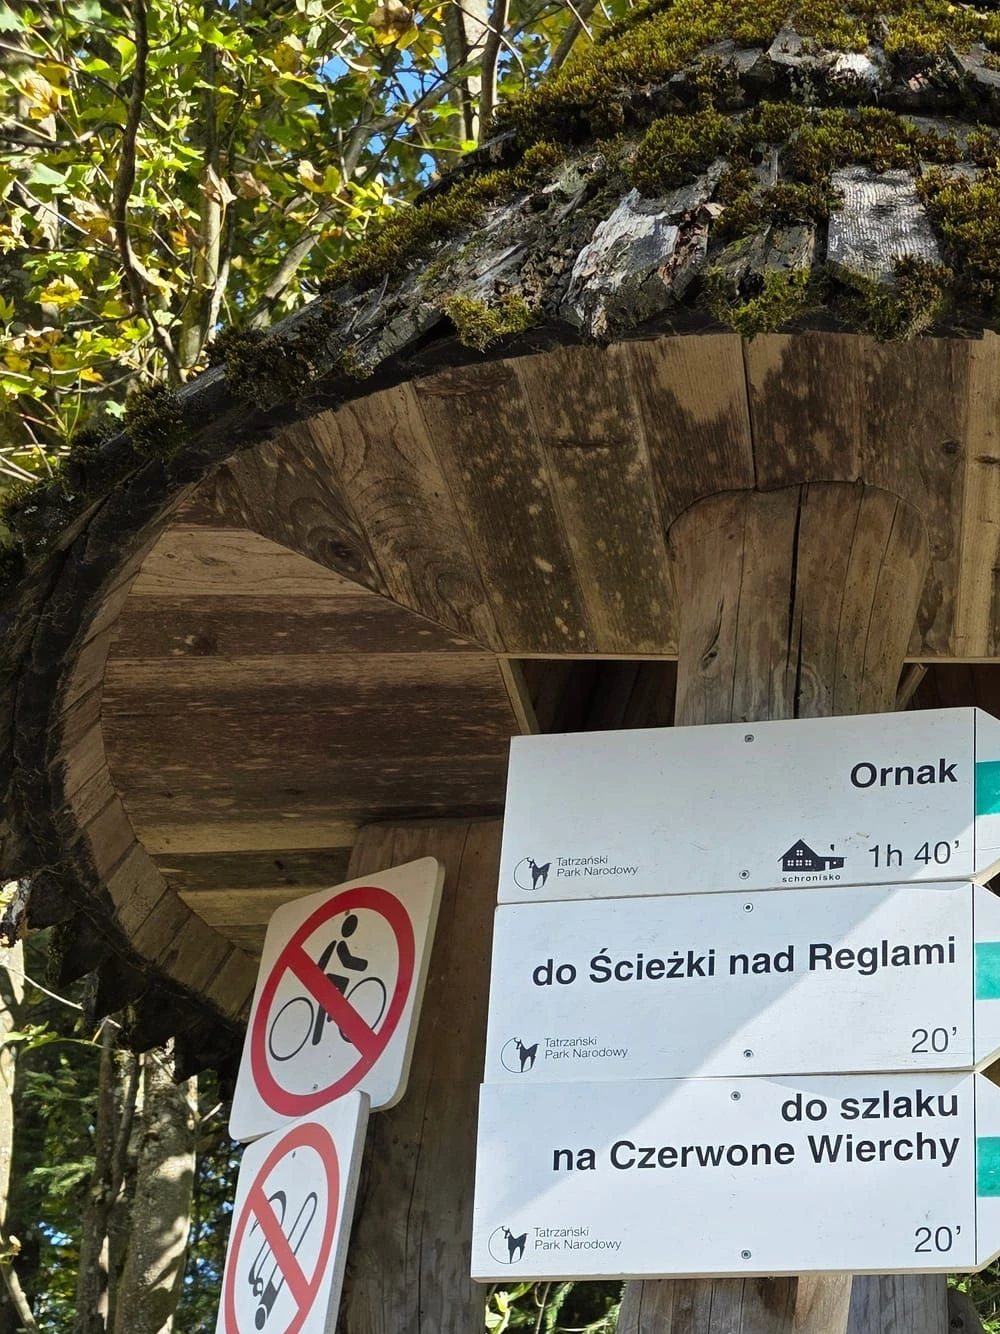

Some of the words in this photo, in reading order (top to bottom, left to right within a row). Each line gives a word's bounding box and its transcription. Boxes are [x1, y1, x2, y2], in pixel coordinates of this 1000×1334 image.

[850, 757, 958, 789] Ornak
[868, 843, 903, 868] 1h
[556, 867, 582, 878] Park
[583, 865, 639, 877] Narodowy
[781, 873, 842, 883] schronisko
[532, 958, 577, 987] do
[588, 947, 716, 984] Ścieżki
[729, 944, 795, 976] nad
[808, 935, 955, 976] Reglami
[544, 1049, 570, 1060] Park
[572, 1047, 629, 1059] Narodowy
[781, 1092, 828, 1122] do
[840, 1088, 958, 1120] szlaku
[552, 1148, 597, 1171] na
[610, 1140, 795, 1170] Czerwone
[807, 1131, 960, 1168] Wierchy
[534, 1239, 561, 1251] Park
[563, 1239, 622, 1252] Narodowy
